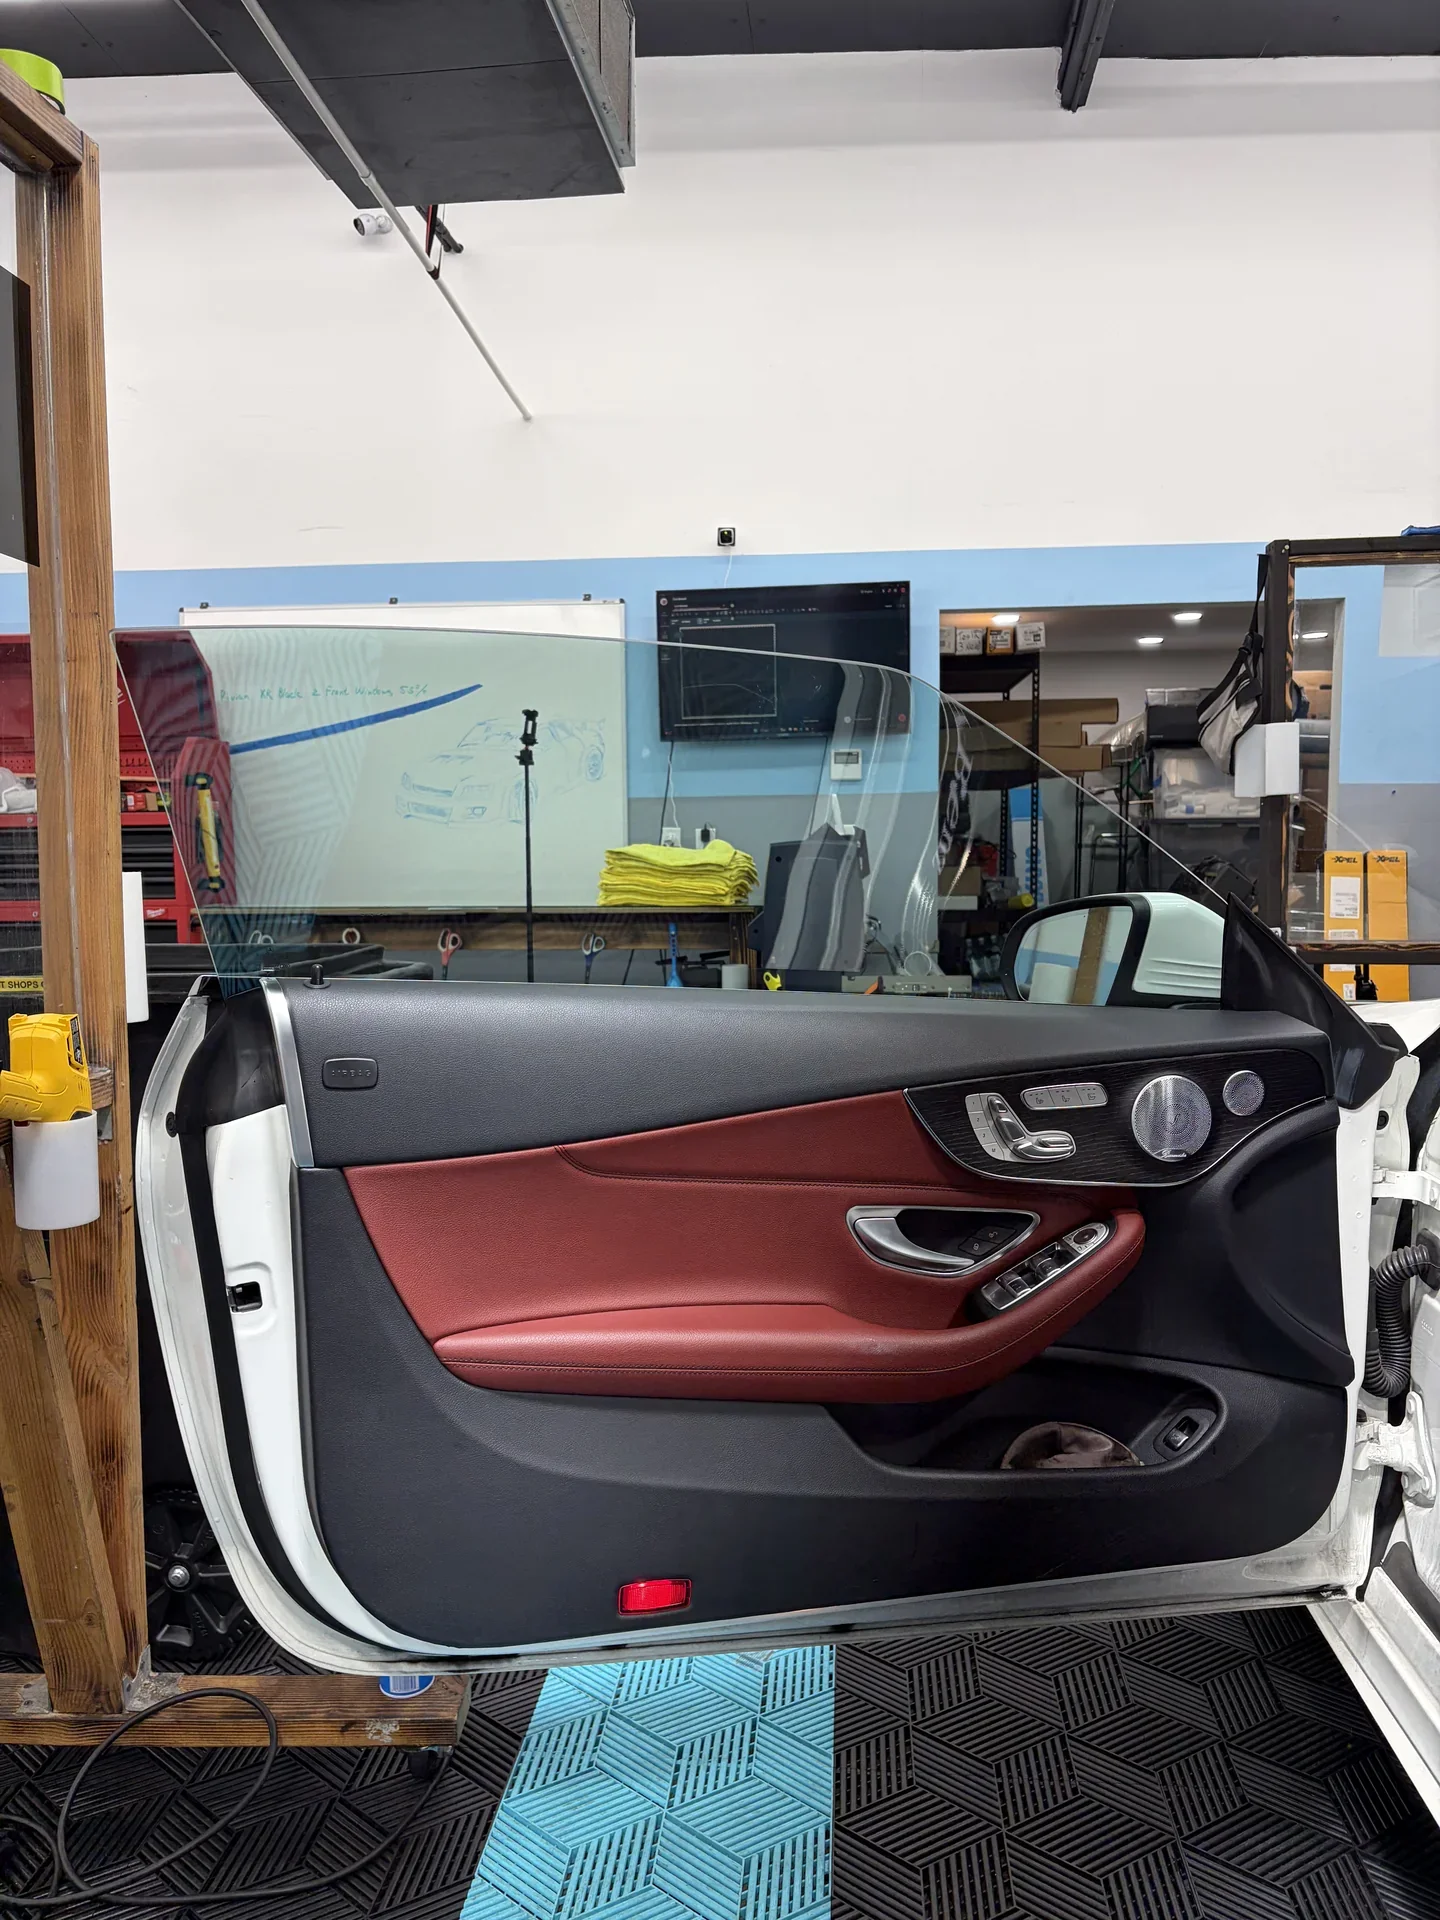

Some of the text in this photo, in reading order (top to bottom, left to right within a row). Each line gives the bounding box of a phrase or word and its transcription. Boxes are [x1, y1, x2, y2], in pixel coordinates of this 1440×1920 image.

[325, 685, 349, 697] Front
[1332, 855, 1358, 864] XPEL
[1373, 855, 1401, 863] XPEL
[8, 980, 39, 989] SHOPS
